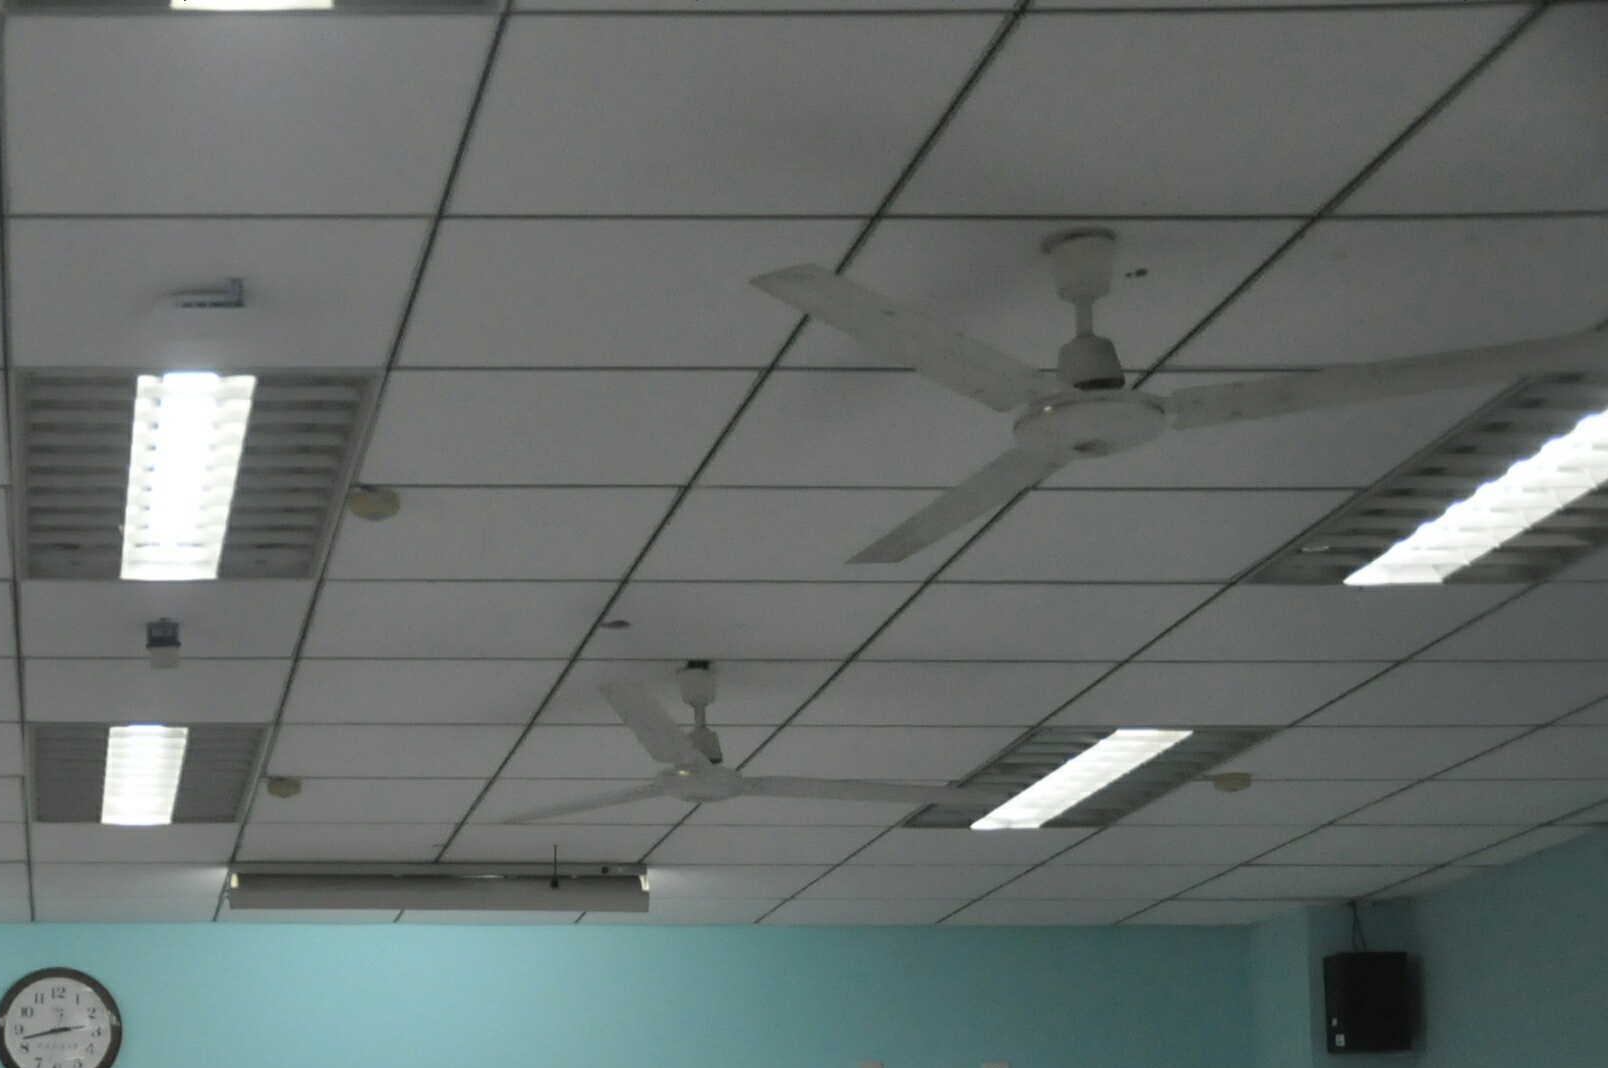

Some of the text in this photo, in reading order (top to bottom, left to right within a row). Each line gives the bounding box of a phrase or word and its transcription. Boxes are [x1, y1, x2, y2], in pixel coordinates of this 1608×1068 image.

[34, 993, 44, 1004] 11
[51, 987, 66, 999] 12
[21, 1006, 34, 1018] 10
[87, 1007, 96, 1019] 2
[14, 1024, 24, 1035] 9
[20, 1041, 29, 1053] 8
[85, 1043, 94, 1054] 4
[34, 1057, 42, 1068] 7
[73, 1058, 83, 1068] 5
